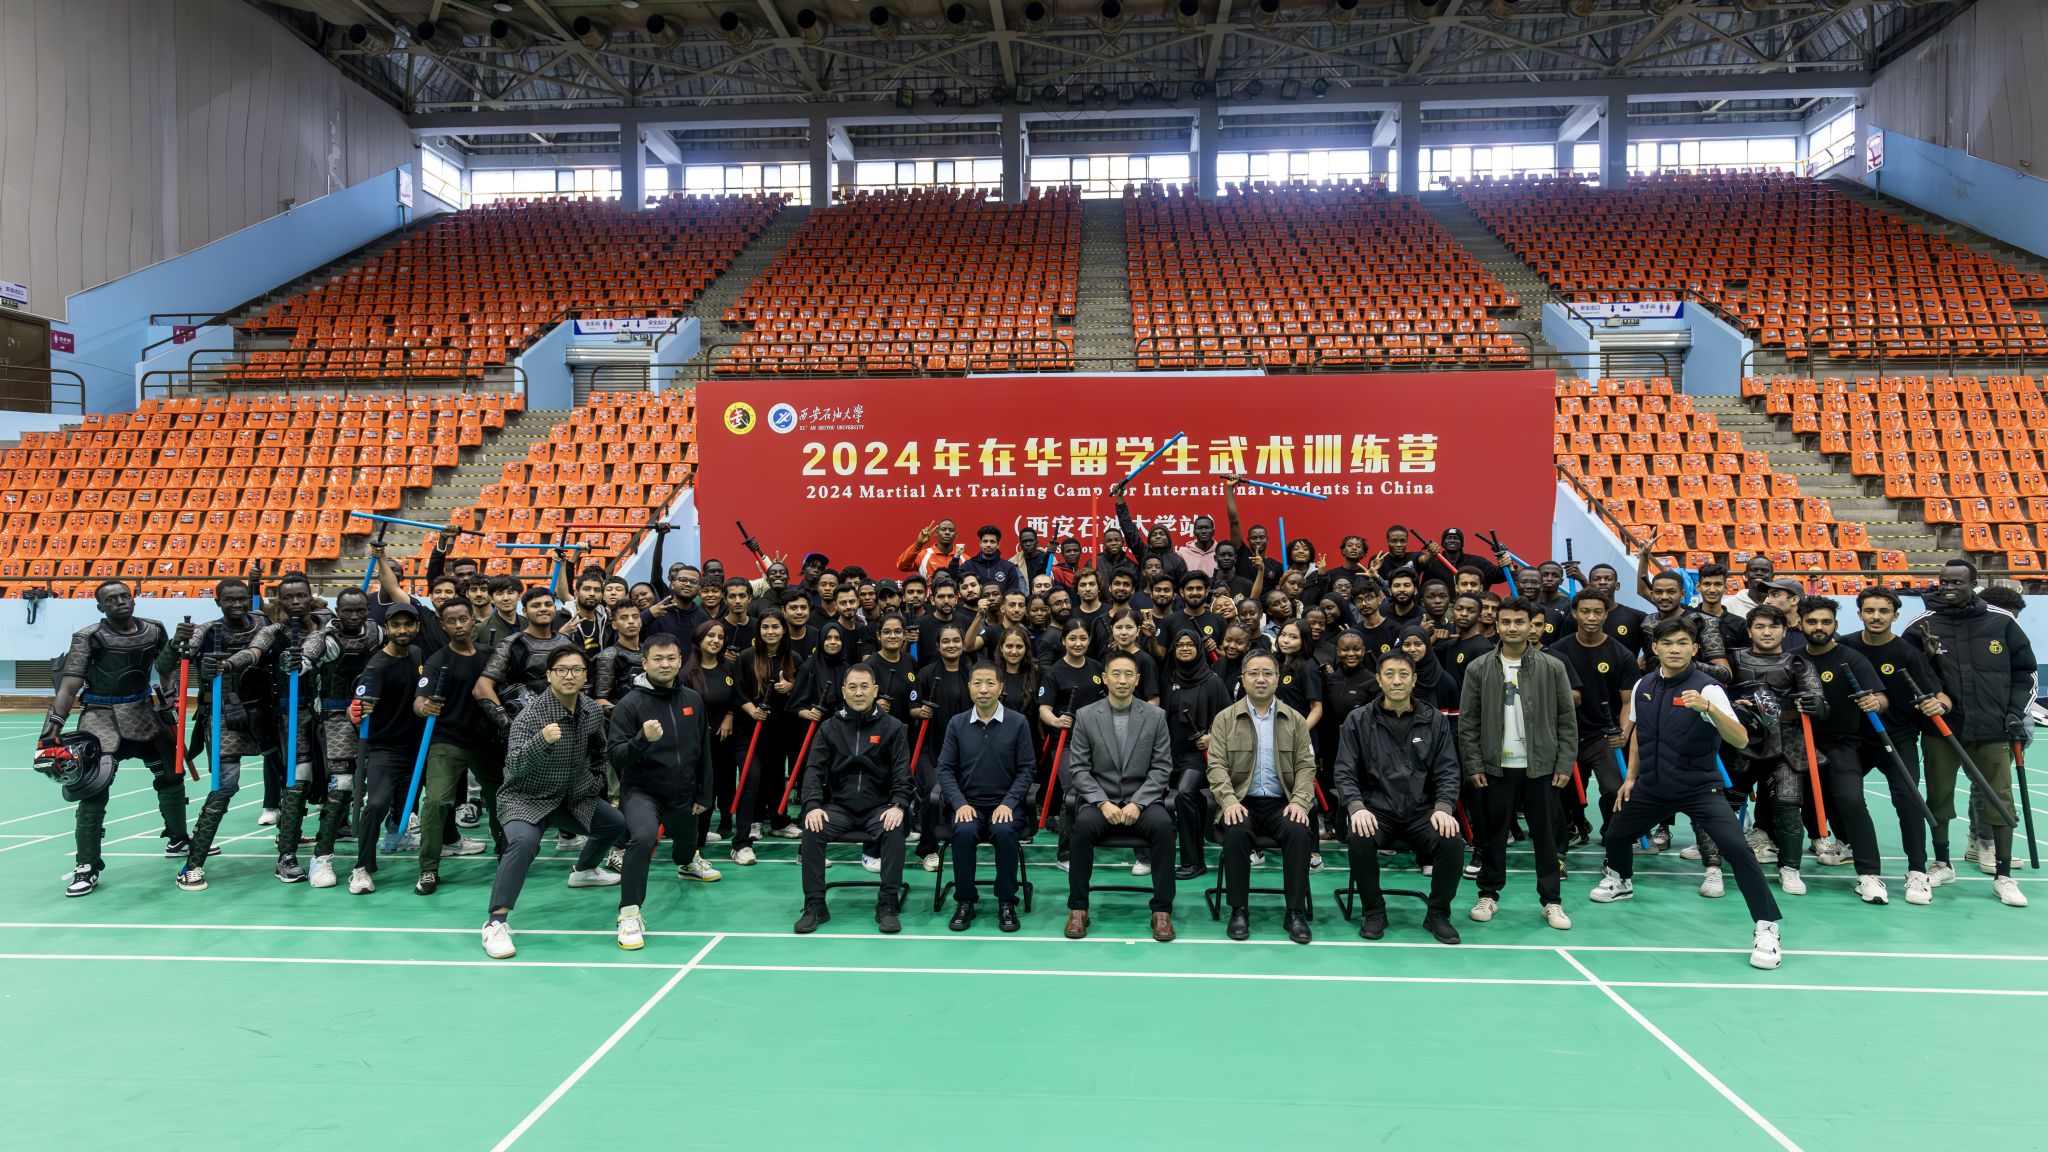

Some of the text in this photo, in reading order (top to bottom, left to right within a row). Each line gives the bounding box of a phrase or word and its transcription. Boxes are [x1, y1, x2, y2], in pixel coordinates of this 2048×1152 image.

[806, 485, 853, 499] 2024
[859, 484, 926, 498] Martial
[932, 484, 962, 498] Art
[967, 483, 1047, 500] Training
[1053, 483, 1103, 500] Camp
[1144, 482, 1264, 497] Internatinal
[1356, 481, 1374, 495] in
[1380, 480, 1435, 495] China
